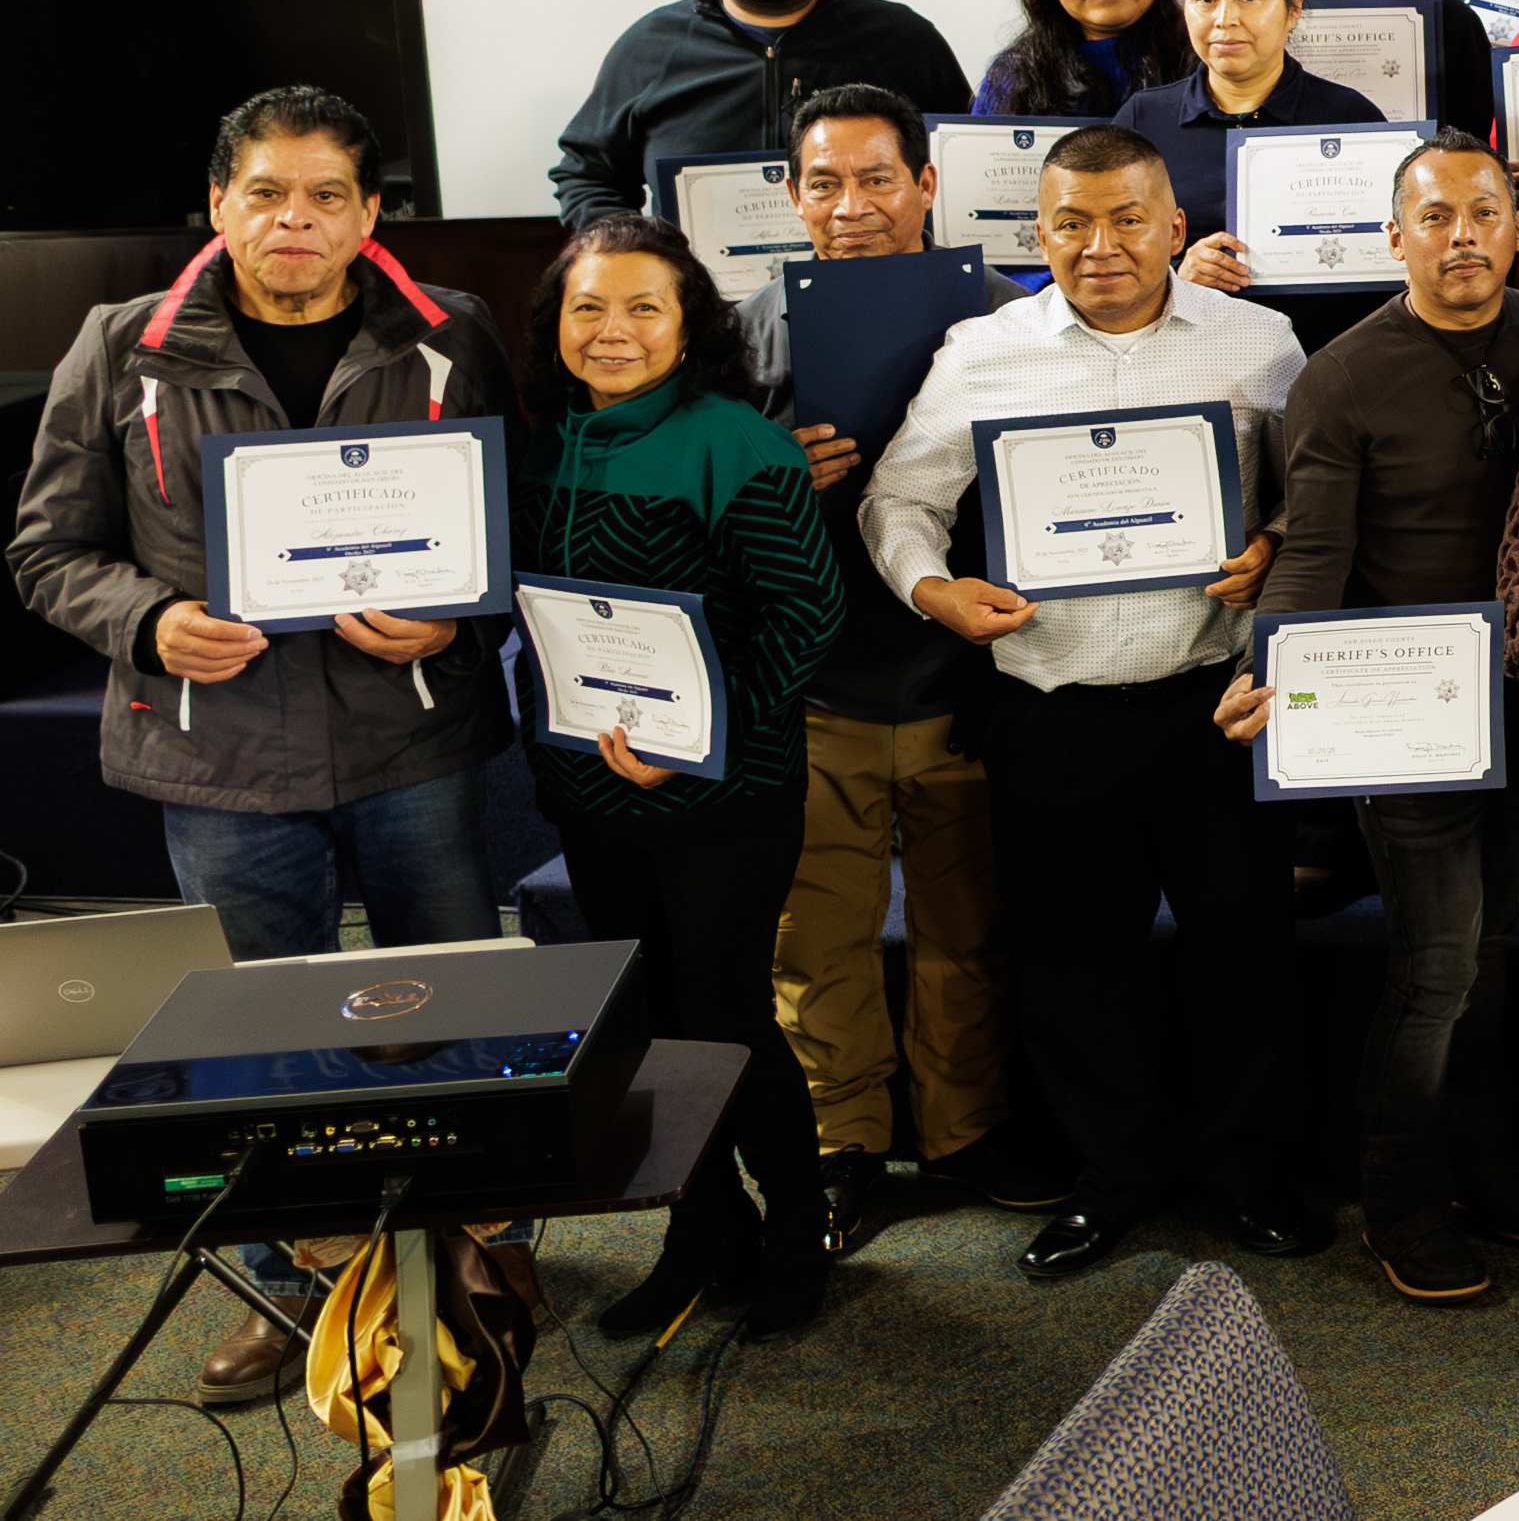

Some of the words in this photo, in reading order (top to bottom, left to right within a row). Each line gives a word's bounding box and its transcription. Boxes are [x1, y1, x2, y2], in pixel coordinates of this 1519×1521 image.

[1287, 34, 1342, 43] ERIFF'S
[1347, 33, 1395, 41] OFFICE
[985, 167, 1042, 178] CERTIFIC
[1290, 177, 1373, 190] CERTIFICADO
[736, 200, 790, 214] CERTIFIC
[1059, 466, 1160, 484] CERTIFICADO
[302, 488, 415, 507] CERTIFICADO
[578, 634, 656, 654] CERTIFICADO
[1303, 648, 1388, 663] SHERIFF'S
[1395, 646, 1455, 657] OFFICE
[1321, 667, 1368, 675] CERTIFICATE
